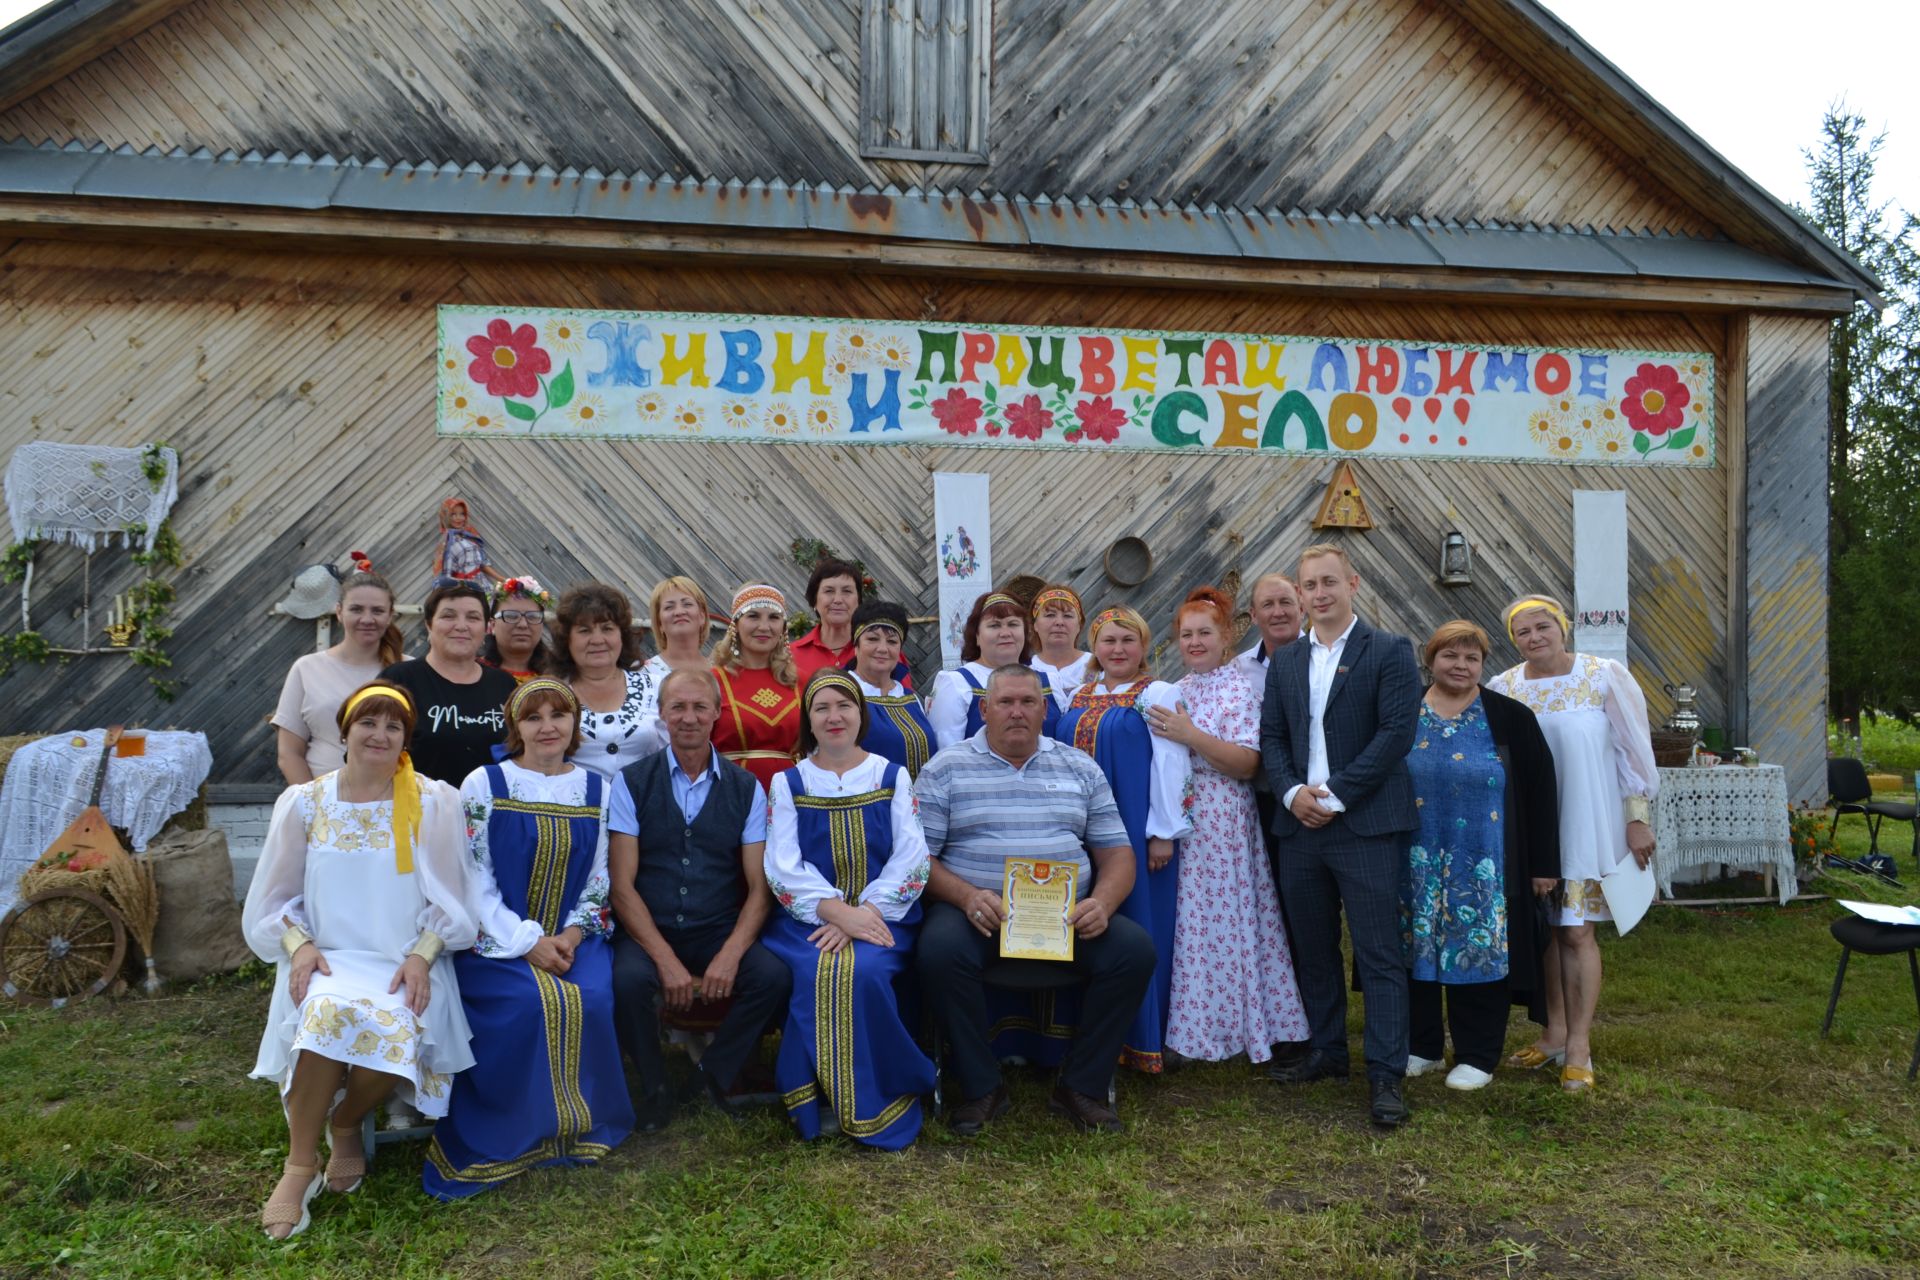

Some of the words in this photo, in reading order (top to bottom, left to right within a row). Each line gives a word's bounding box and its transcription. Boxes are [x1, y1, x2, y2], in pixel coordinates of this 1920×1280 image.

[587, 321, 832, 395] ЖИВИ
[847, 368, 904, 433] И
[1307, 343, 1609, 399] ЛЮБИМОЕ
[427, 704, 505, 733] Moments
[1020, 893, 1059, 901] ПИСЬМО
